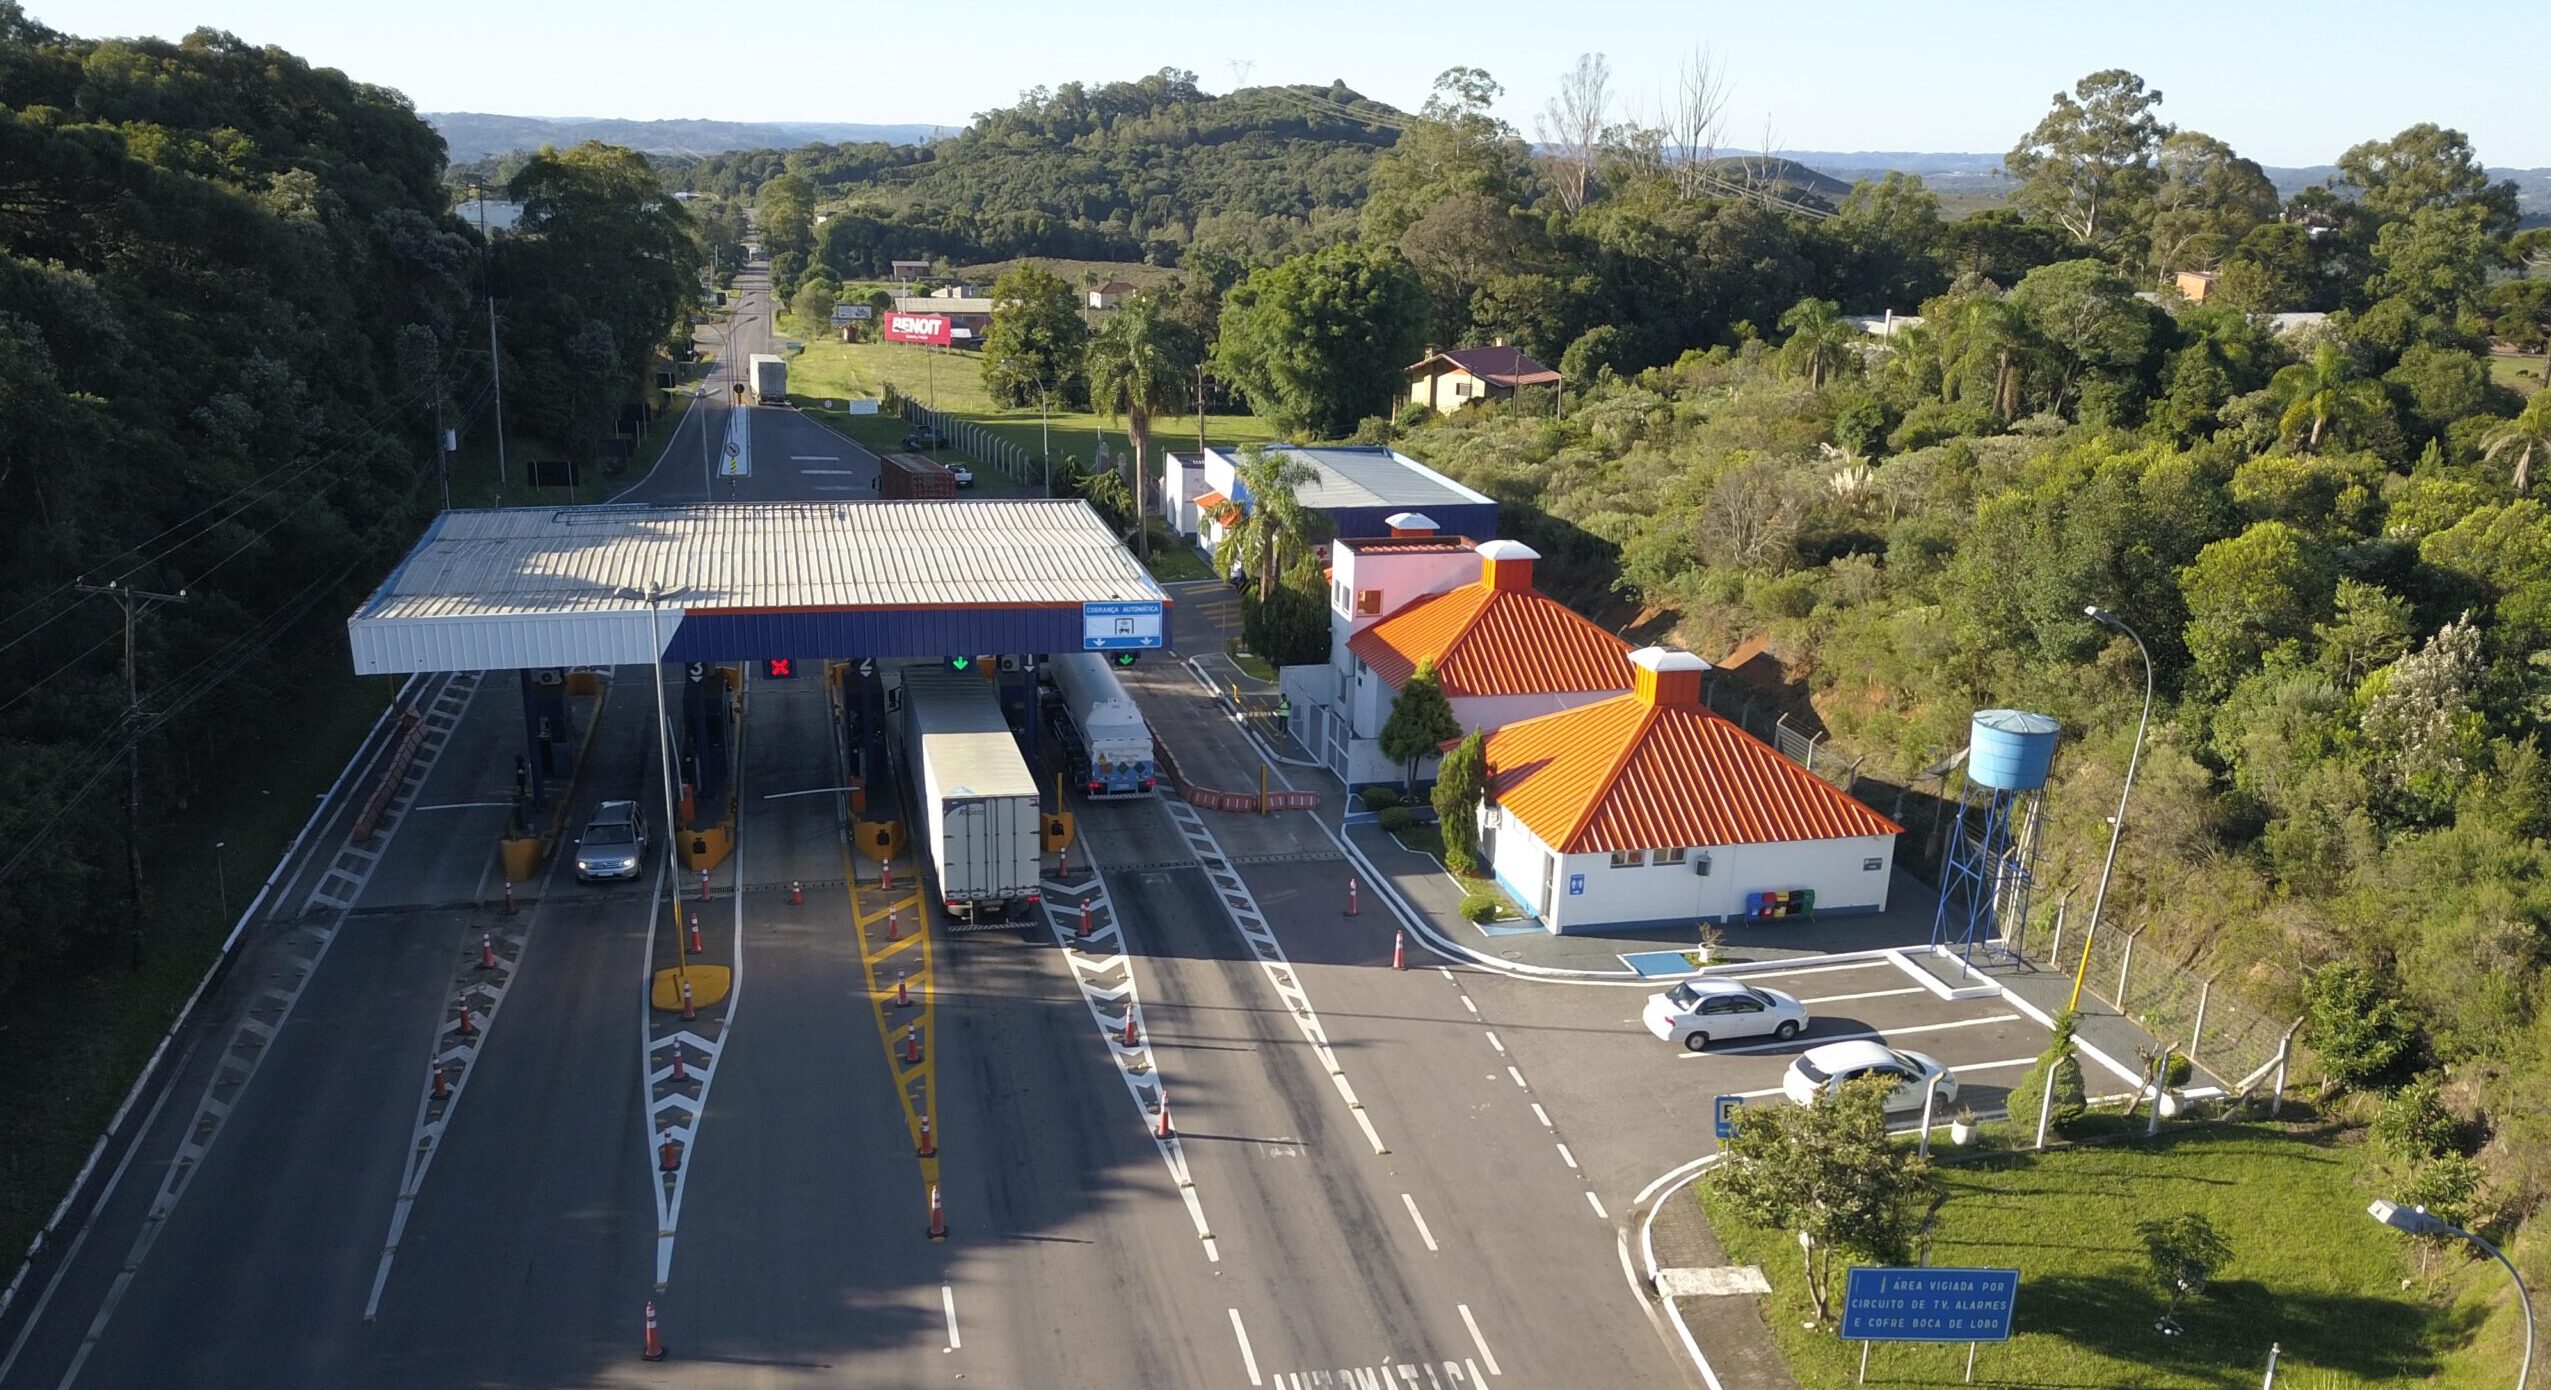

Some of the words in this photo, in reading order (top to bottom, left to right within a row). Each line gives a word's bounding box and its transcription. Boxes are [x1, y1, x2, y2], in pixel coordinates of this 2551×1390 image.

[892, 317, 942, 335] BENOIT
[1086, 606, 1120, 614] COBRANÇA
[1122, 604, 1158, 613] AUTOMÁTICA
[690, 661, 704, 676] 3
[859, 657, 872, 670] 2
[1893, 1276, 1923, 1291] ÁREA
[1929, 1281, 1974, 1292] VIGIADA
[1982, 1282, 2005, 1292] POR
[1851, 1299, 1904, 1309] CIRCUITO
[1911, 1299, 1926, 1309] DE
[1955, 1301, 2007, 1311] ALARMES
[1854, 1317, 1862, 1328] E
[1868, 1318, 1905, 1328] COFRE
[1912, 1318, 1941, 1329] BOCA
[1949, 1319, 1963, 1329] DE
[1970, 1319, 1999, 1329] LOBO
